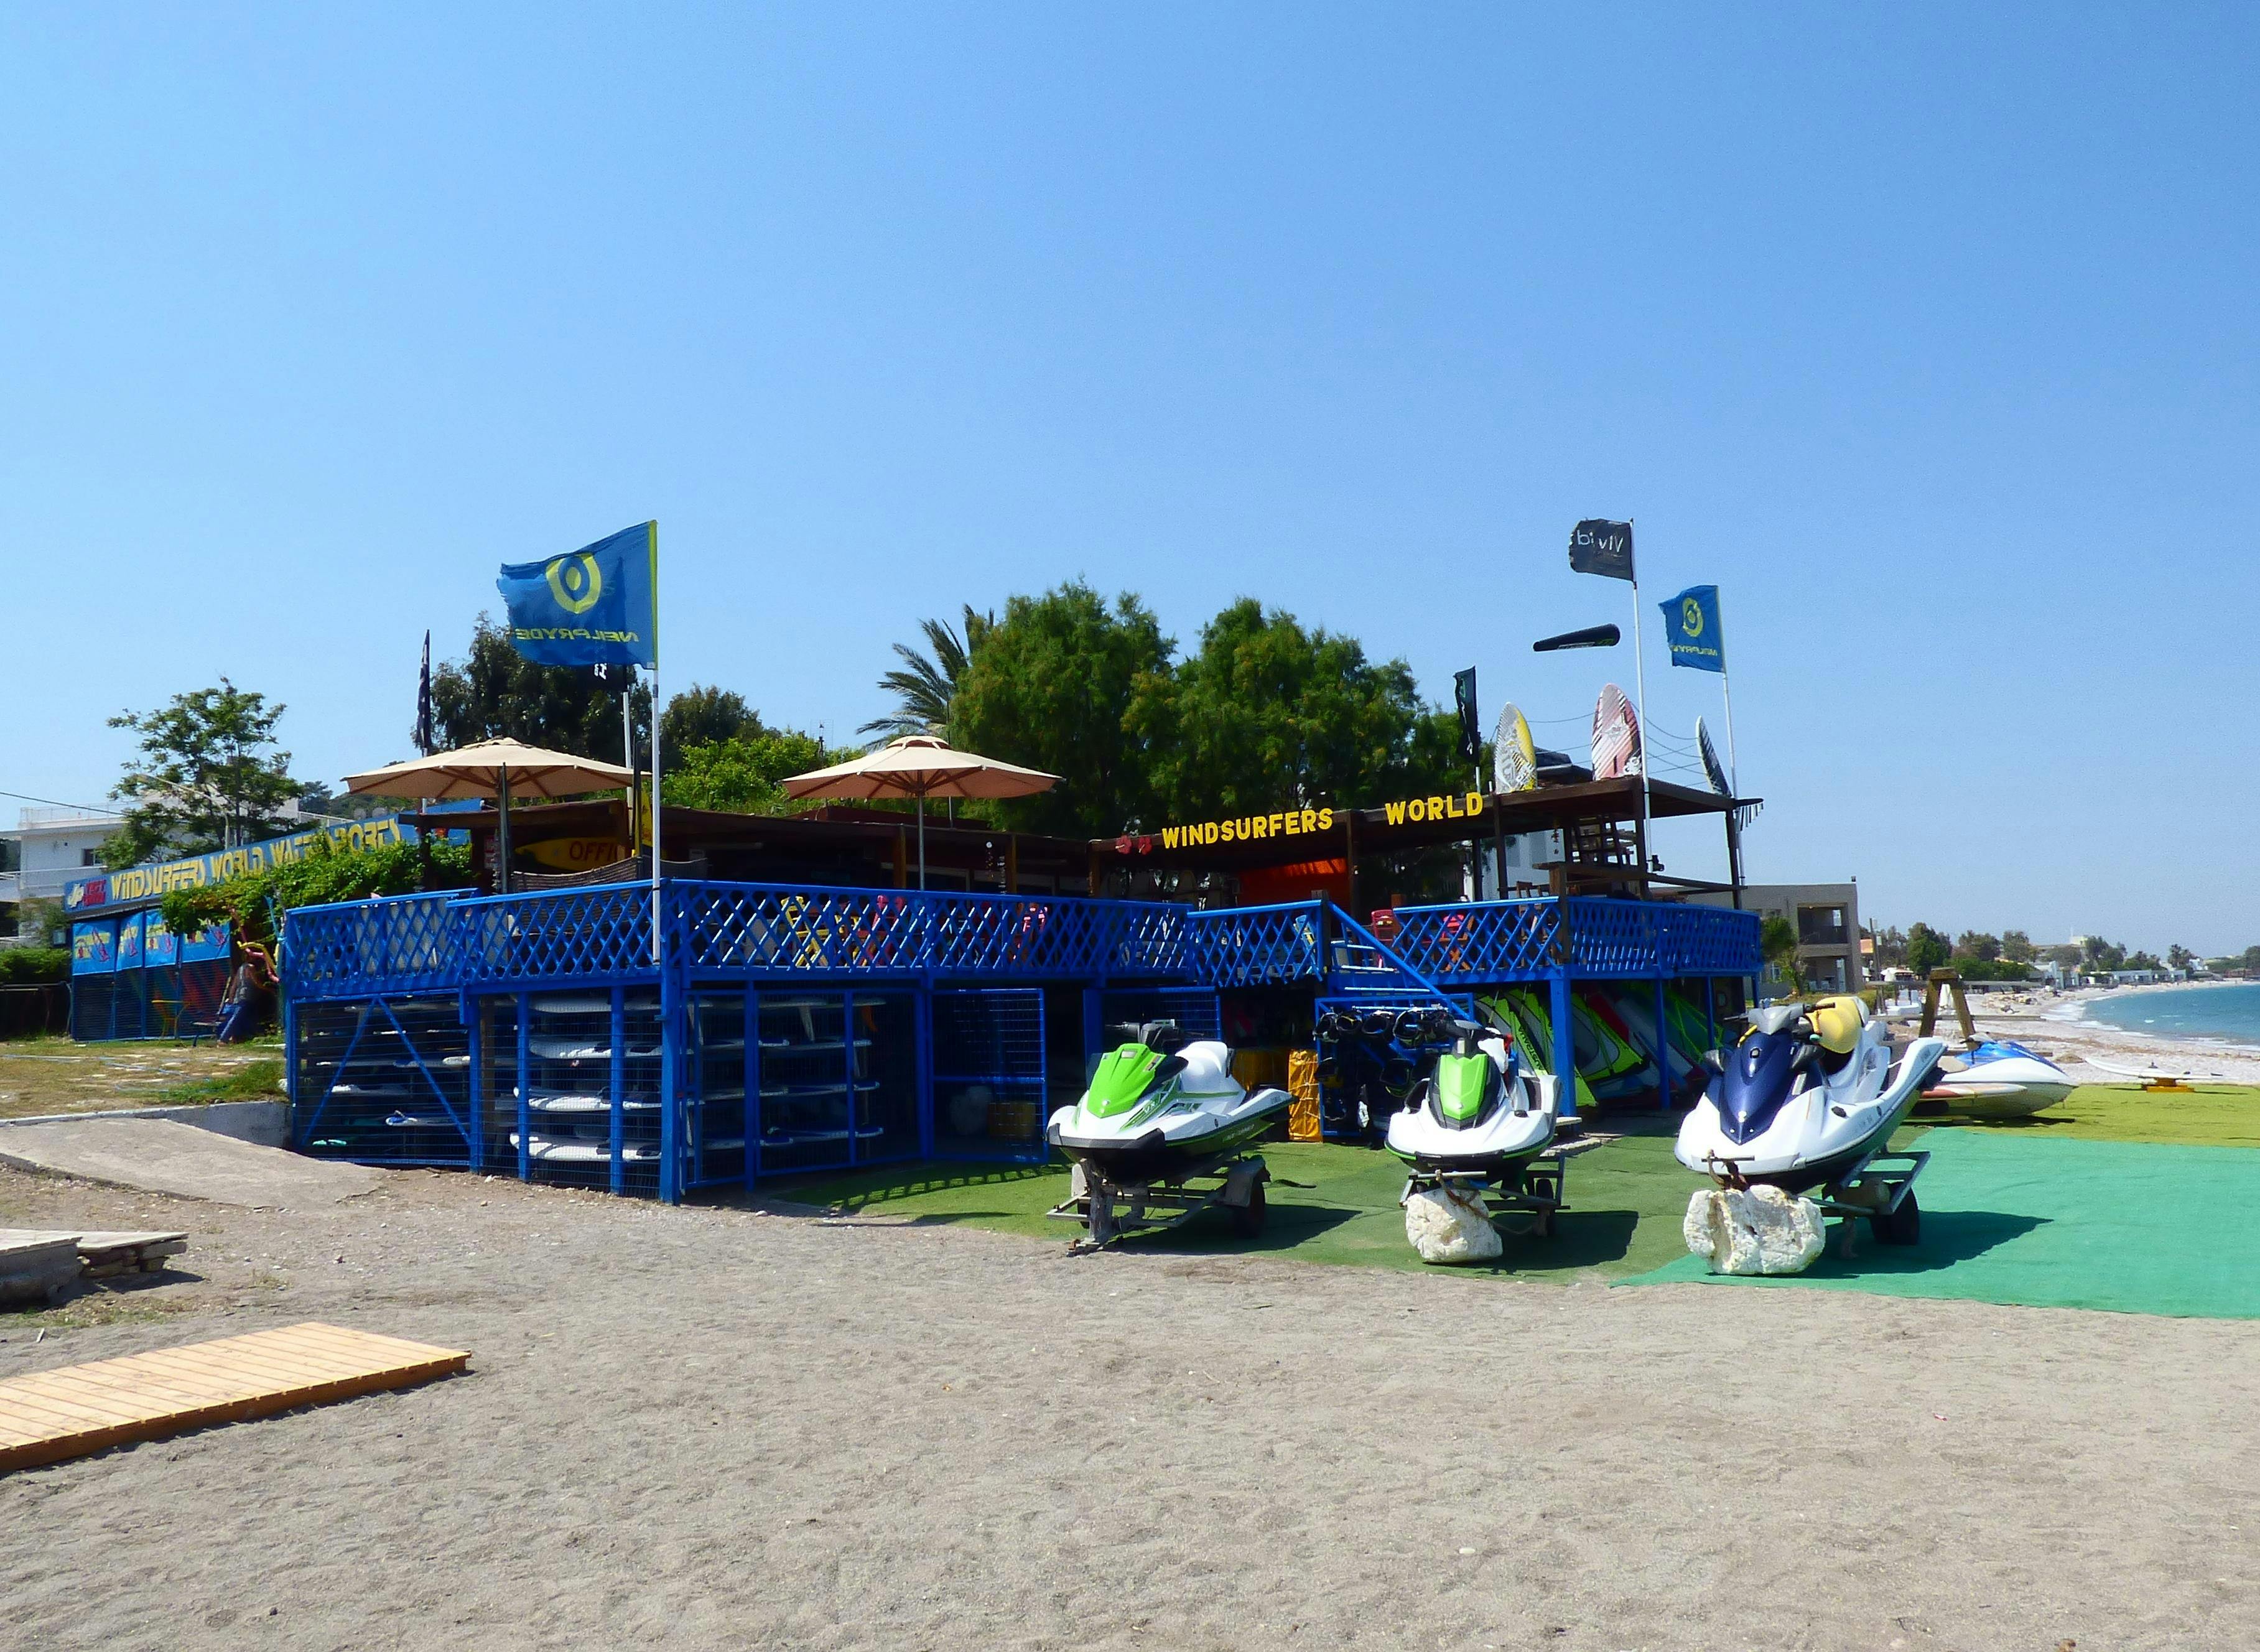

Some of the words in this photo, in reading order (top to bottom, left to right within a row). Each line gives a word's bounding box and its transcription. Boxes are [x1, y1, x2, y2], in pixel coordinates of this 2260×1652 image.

[1161, 809, 1333, 848] WINDSURFERS
[1385, 792, 1484, 825] WORLD
[111, 859, 205, 900] WINDSURFERS
[210, 847, 265, 883] WORLD
[270, 833, 323, 867] WATE
